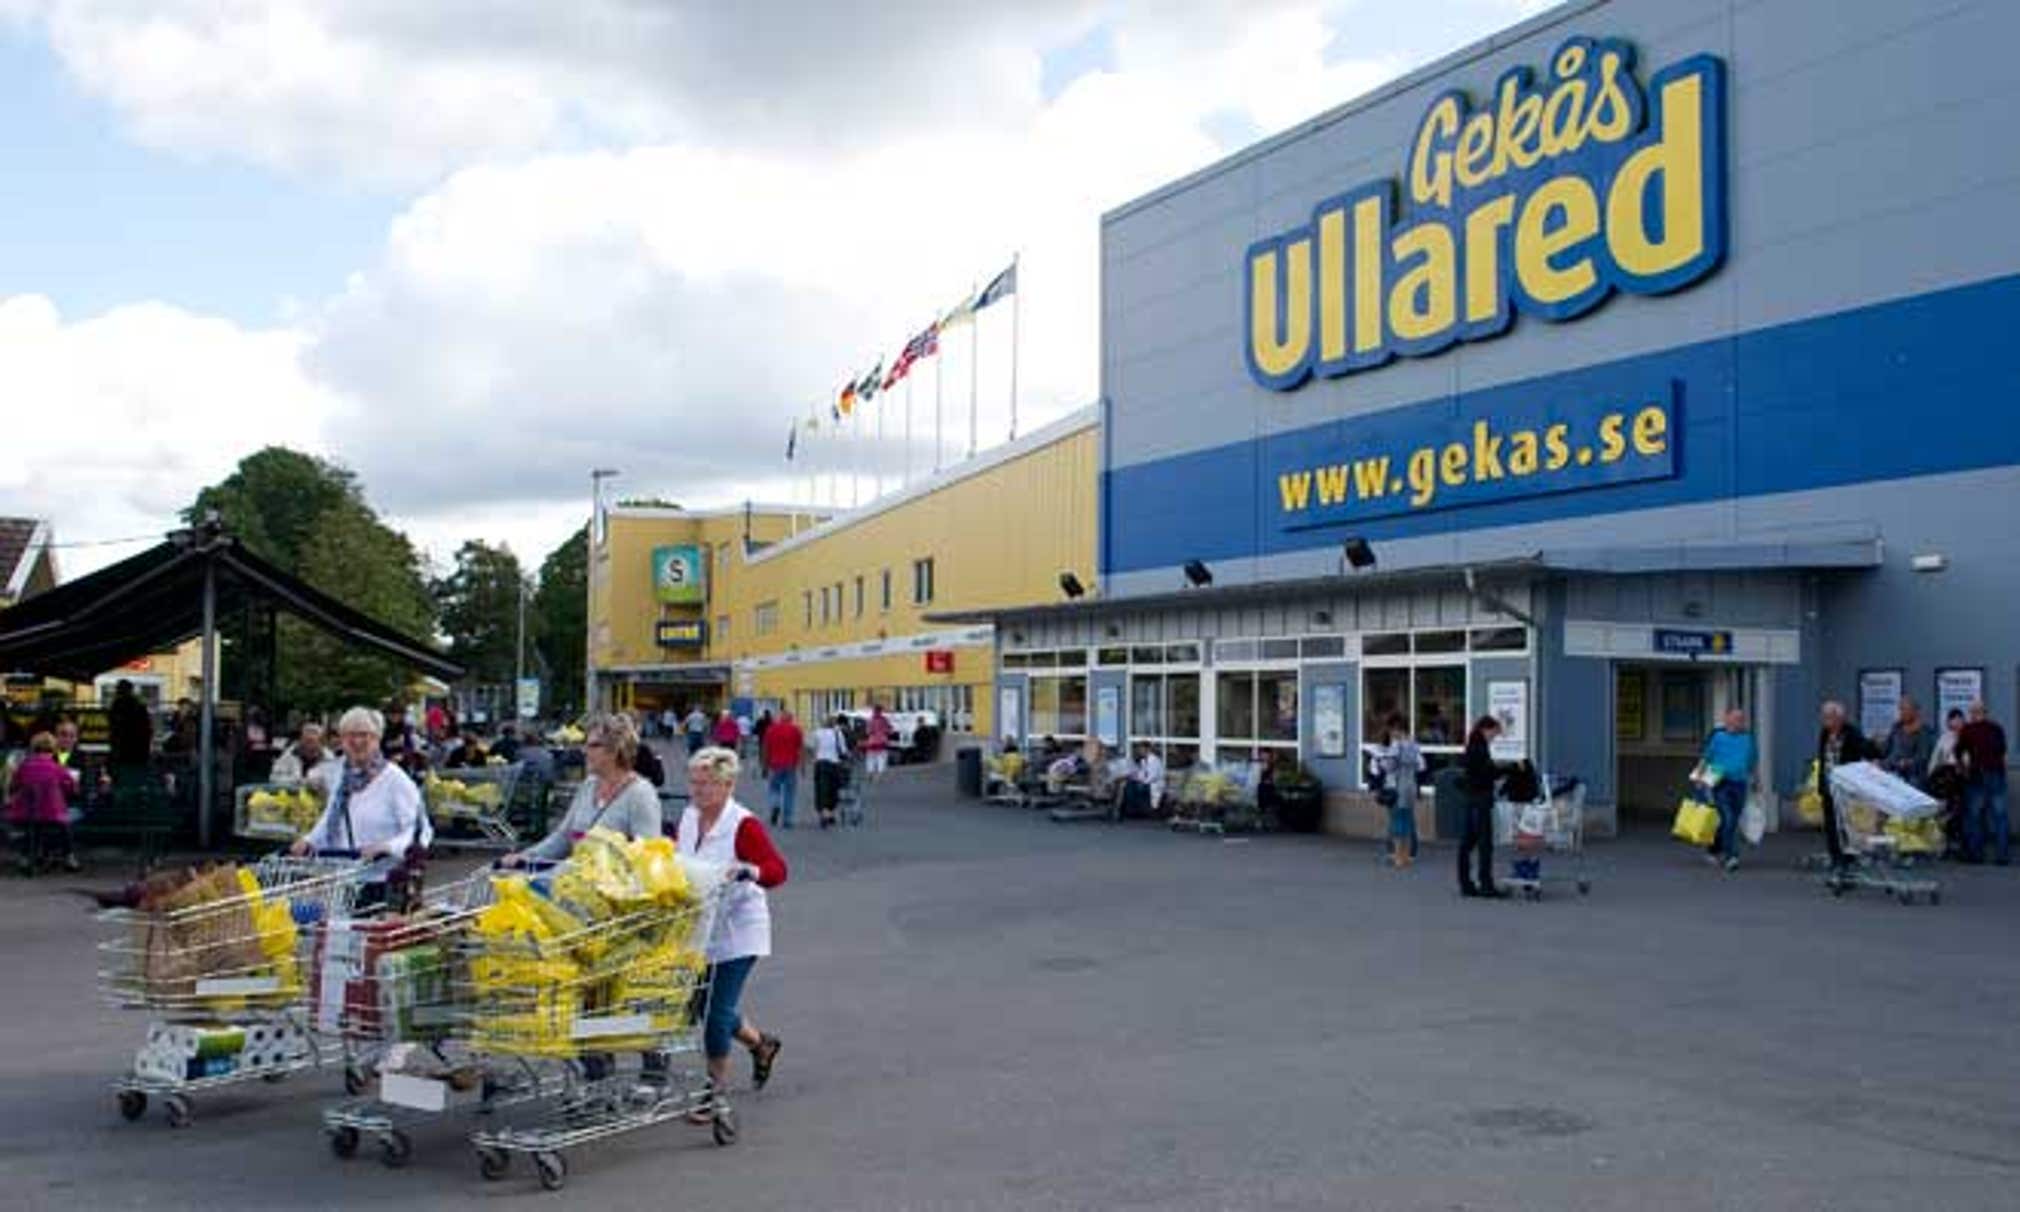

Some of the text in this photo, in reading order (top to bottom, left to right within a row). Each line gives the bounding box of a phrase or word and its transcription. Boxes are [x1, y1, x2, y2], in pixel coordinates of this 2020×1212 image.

[1411, 46, 1630, 206] Gekås
[1252, 74, 1702, 376] Ullared
[1279, 406, 1667, 509] www.gekas.se
[669, 558, 684, 583] S
